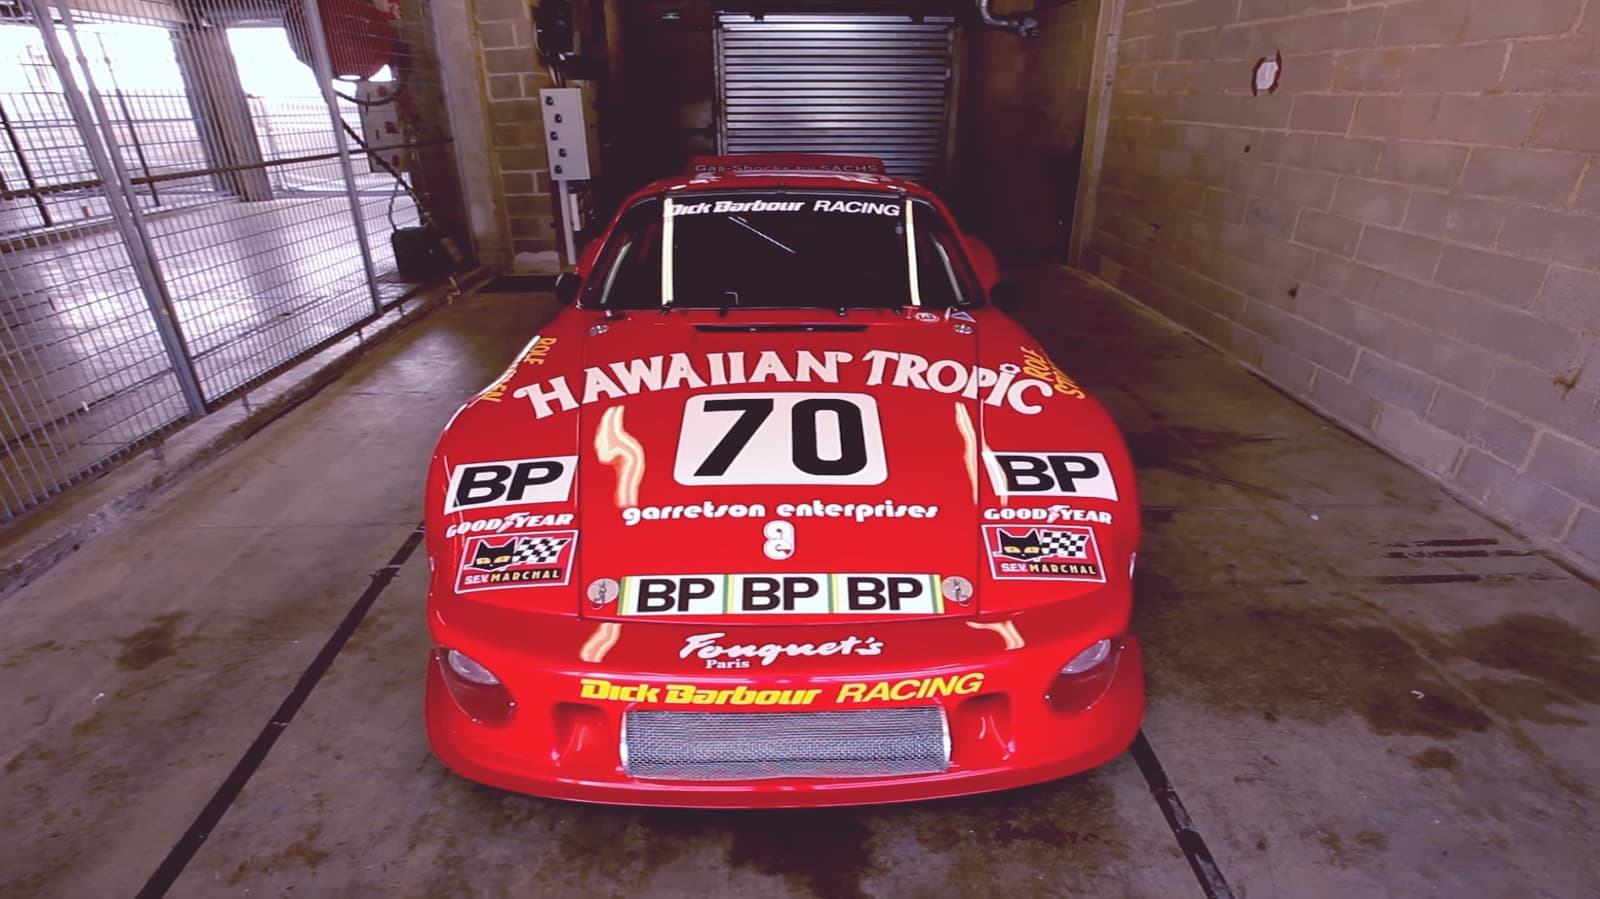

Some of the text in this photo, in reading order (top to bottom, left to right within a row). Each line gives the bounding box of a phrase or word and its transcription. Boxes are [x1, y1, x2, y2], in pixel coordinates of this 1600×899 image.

[821, 164, 878, 173] SACHS
[663, 200, 901, 217] Dick Barbour RACING
[512, 350, 853, 420] HAWAIIAN
[863, 350, 1053, 415] TROPIC
[693, 397, 867, 477] 70
[452, 460, 564, 508] BP
[994, 455, 1100, 493] BP
[622, 500, 938, 526] garretson enterprises
[490, 569, 560, 583] MARCHAL
[1029, 563, 1097, 575] MARCHAL
[637, 578, 715, 613] BP
[742, 577, 819, 611] BP
[847, 577, 923, 611] BP
[706, 659, 750, 669] Paris
[581, 672, 985, 705] Dick Barbour RACING
